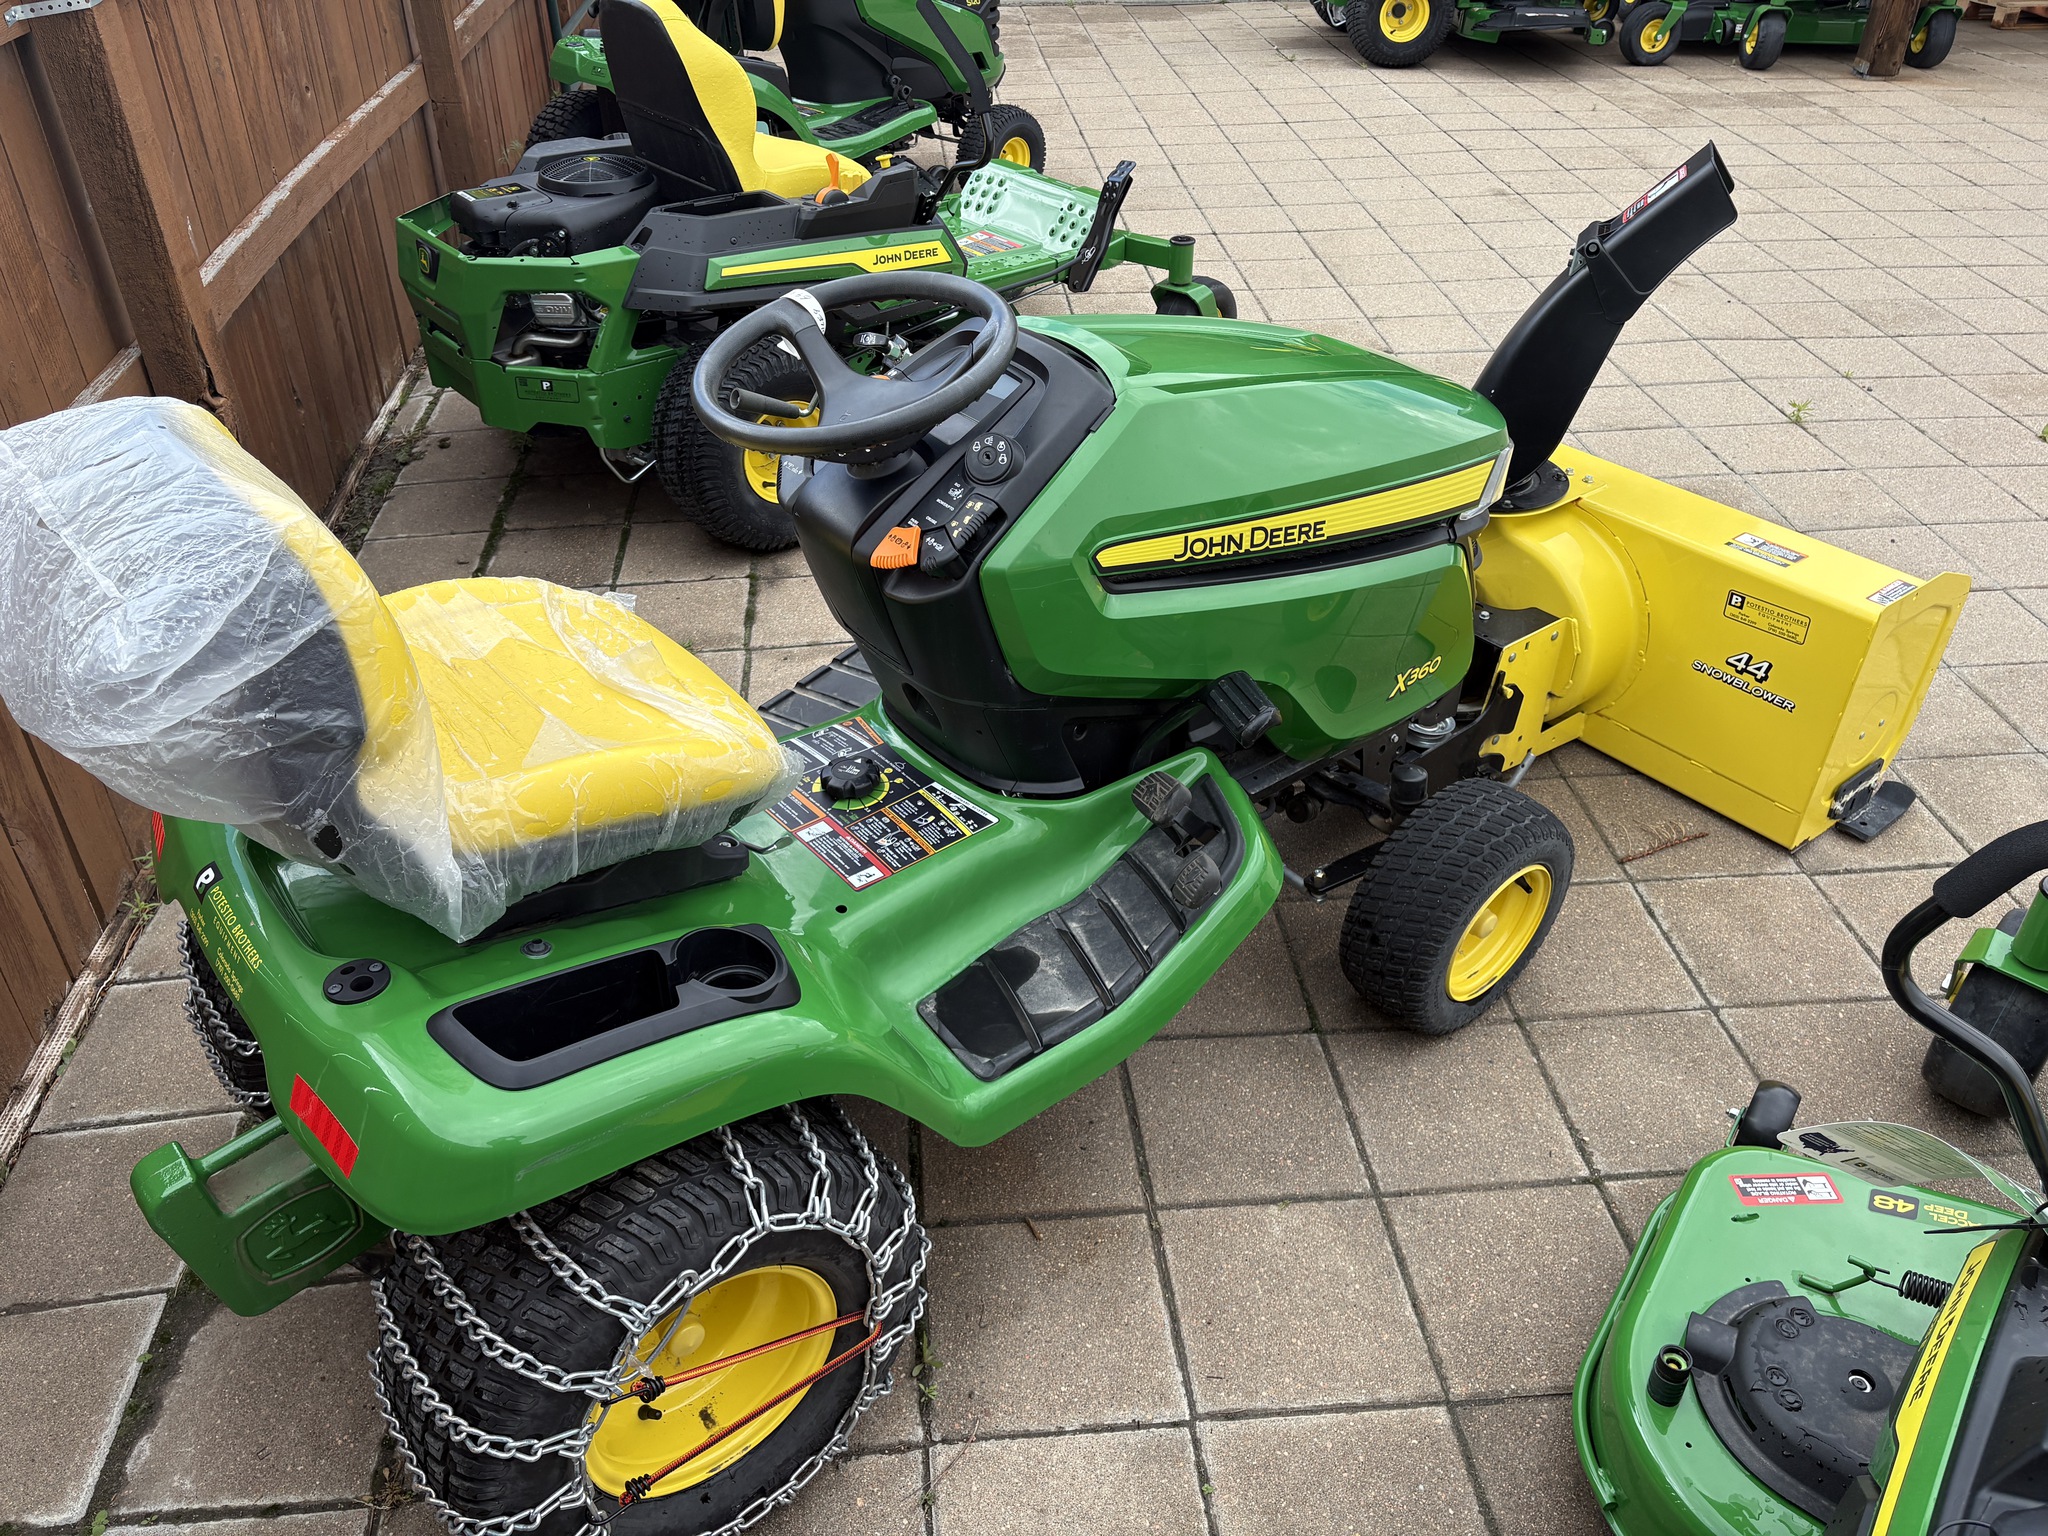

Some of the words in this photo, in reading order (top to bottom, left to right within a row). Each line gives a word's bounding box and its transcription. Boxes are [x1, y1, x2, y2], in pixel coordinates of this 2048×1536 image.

[872, 253, 902, 265] JOHN
[904, 248, 938, 260] DEERE
[1174, 533, 1244, 559] JOHN
[1250, 520, 1327, 549] DEERE
[1746, 600, 1774, 615] POTESTIO
[1776, 612, 1808, 627] BROTHERS
[1758, 612, 1792, 627] EQUIPMENT
[1386, 655, 1442, 700] X360
[1726, 652, 1773, 684] 44
[1692, 659, 1796, 713] SNOWBLOWER
[850, 838, 868, 854] DANGER
[210, 886, 236, 926] POTESTIO
[232, 924, 263, 970] BROTHERS
[213, 916, 241, 964] EQUIPMENT
[1758, 1196, 1788, 1204] DANGER
[1873, 1194, 1916, 1213] 48
[1924, 1204, 1968, 1220] DEEP
[1928, 1212, 1982, 1228] ACCEL
[1944, 1259, 1983, 1322] JOHN
[1908, 1315, 1957, 1408] DEERE
